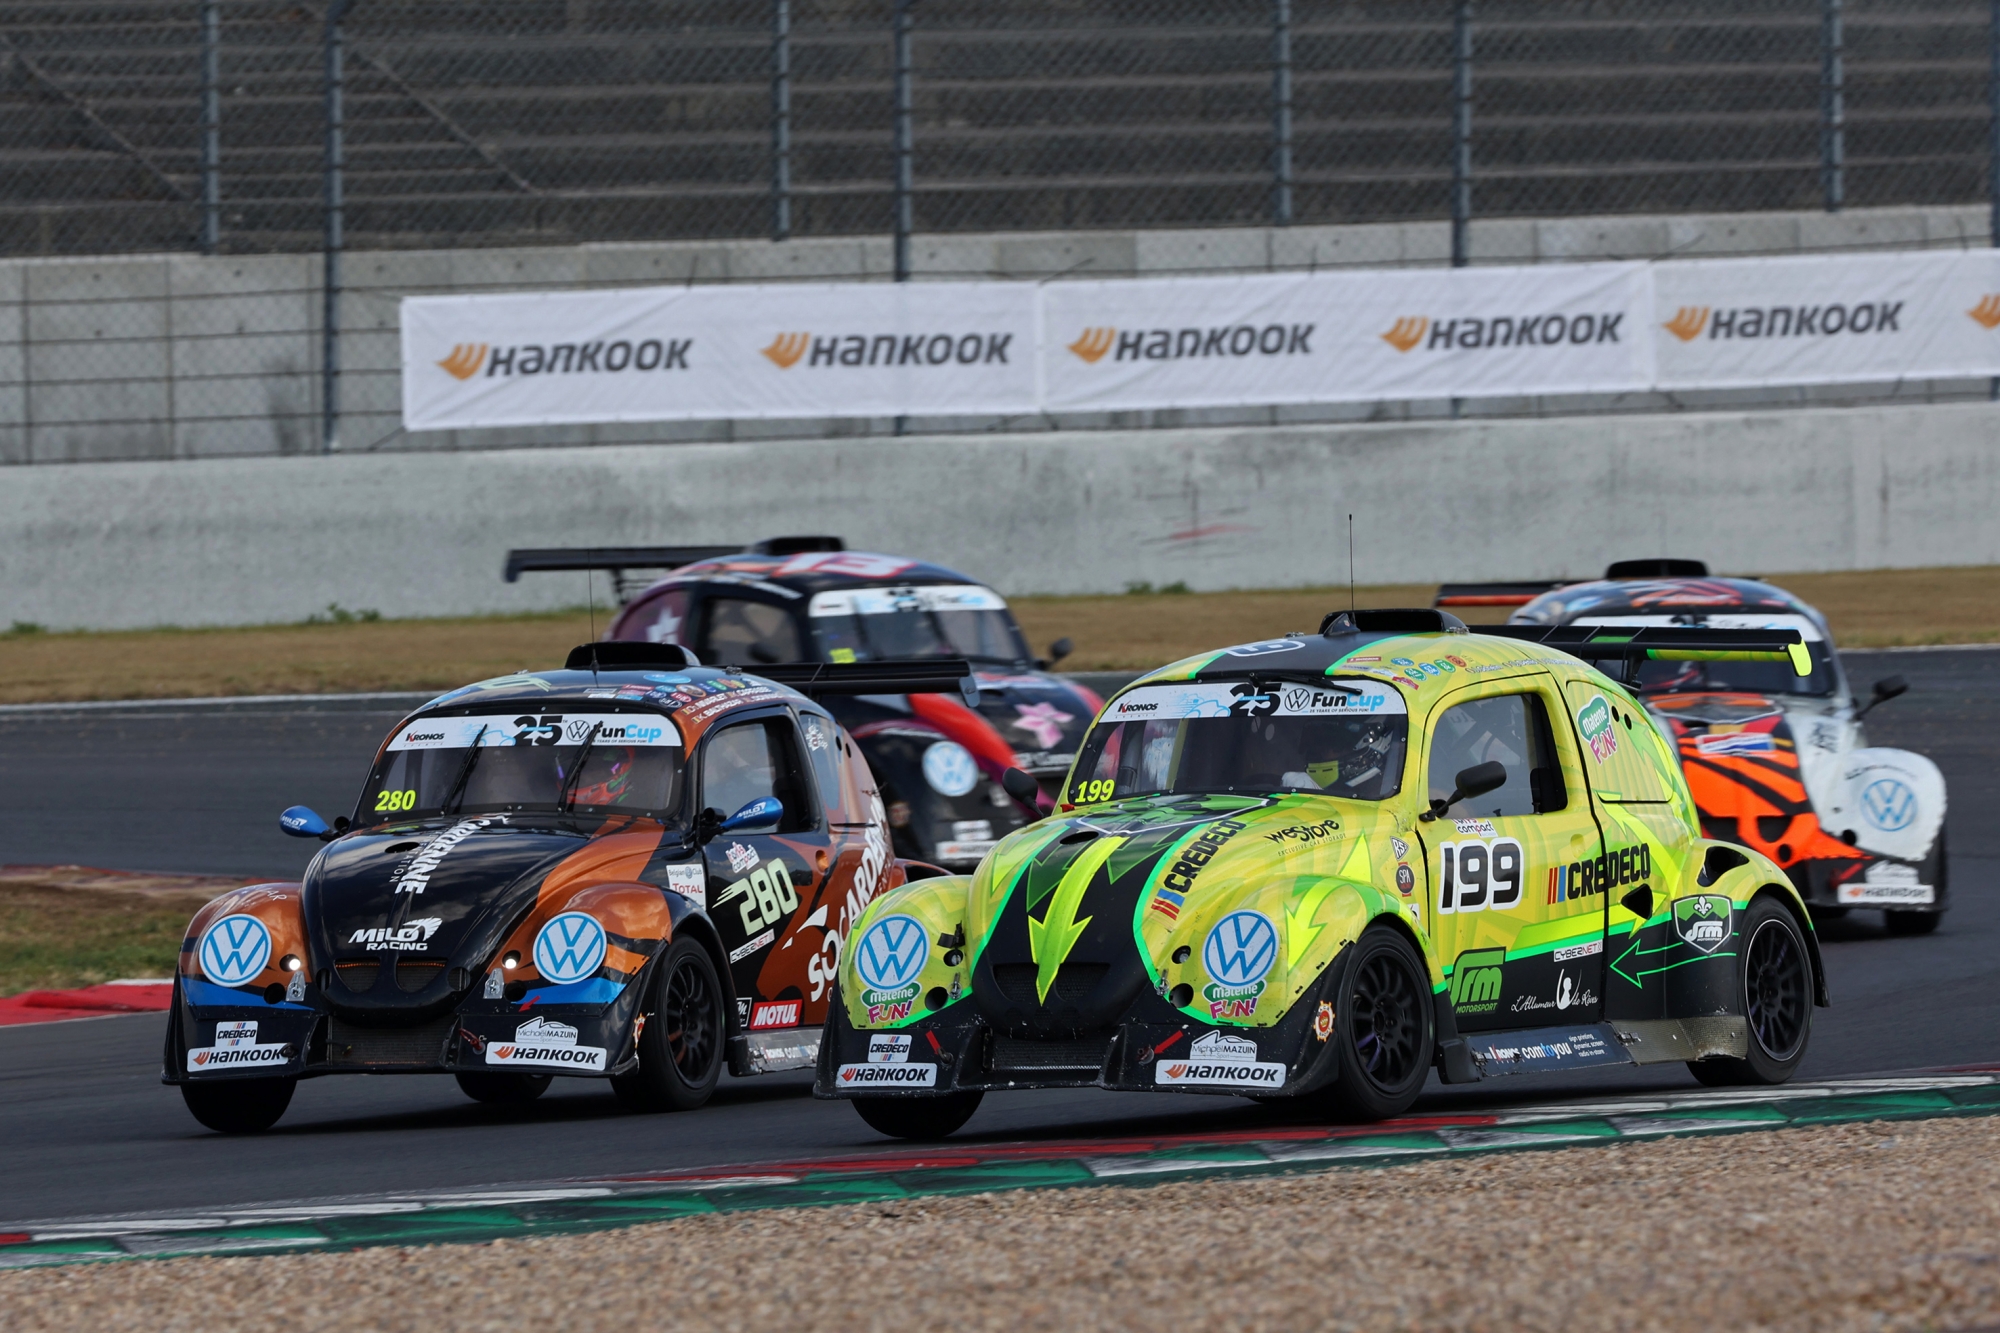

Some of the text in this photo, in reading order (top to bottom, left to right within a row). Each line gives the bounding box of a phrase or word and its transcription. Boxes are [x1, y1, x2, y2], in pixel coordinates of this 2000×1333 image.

[1709, 299, 1904, 340] HANKOOK
[1115, 322, 1314, 362] HANKOOK
[1427, 312, 1623, 351] HANKOOK
[486, 338, 693, 377] HANKOOK
[809, 331, 1013, 368] HANKOOK
[1117, 700, 1159, 713] KRONOS
[1230, 683, 1281, 716] 25
[1311, 692, 1385, 712] FunCup
[405, 730, 445, 742] KRONOS
[513, 715, 563, 746] 25
[1590, 724, 1617, 765] FUN!
[374, 790, 417, 811] 280
[1074, 779, 1116, 803] 199
[1457, 821, 1495, 836] compact
[1277, 833, 1347, 857] EXCLUSIVE CAR STORAGE
[1163, 820, 1247, 893] CREDECO
[1398, 868, 1411, 884] SPA
[1438, 837, 1524, 914] 199
[1567, 843, 1651, 900] CREDECO
[672, 883, 703, 894] TOTAL
[711, 858, 799, 936] 280
[366, 941, 428, 951] RACING
[1554, 943, 1598, 961] CYBERNET
[753, 1003, 798, 1026] MOTUL
[868, 1000, 913, 1024] FUN!
[1210, 998, 1258, 1019] FUN!
[1455, 1002, 1498, 1014] MOTORSPORT
[217, 1029, 257, 1039] CREDECO
[208, 1048, 282, 1064] HANKOOK
[512, 1048, 599, 1064] HANKOOK
[870, 1043, 909, 1053] CREDECO
[1521, 1043, 1573, 1059] comtoyou
[854, 1068, 930, 1082] HANKOOK
[1185, 1065, 1278, 1081] HANKOOK
